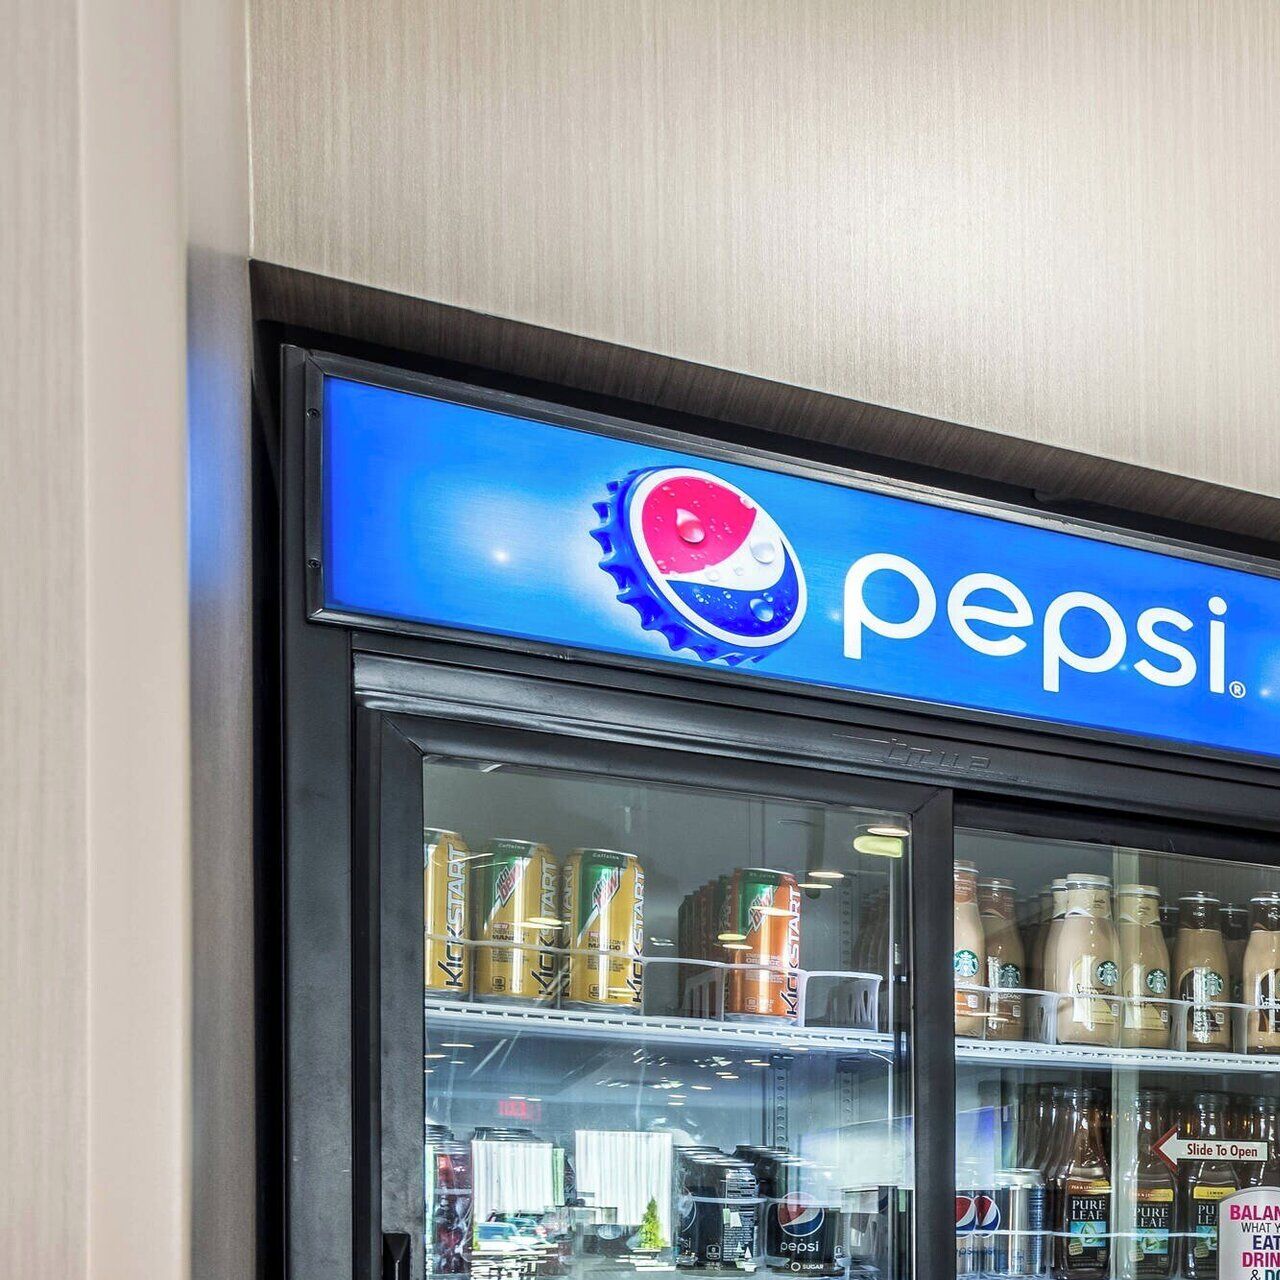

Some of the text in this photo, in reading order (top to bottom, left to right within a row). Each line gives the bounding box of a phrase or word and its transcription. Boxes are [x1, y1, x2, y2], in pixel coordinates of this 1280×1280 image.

[843, 552, 1228, 694] pepsi
[1187, 1143, 1258, 1158] Slide To Open
[1072, 1199, 1106, 1211] PURE
[1072, 1210, 1104, 1221] LEAF
[1133, 1206, 1169, 1218] PURE
[1241, 1222, 1272, 1234] WHAT
[780, 1240, 819, 1254] pepsi
